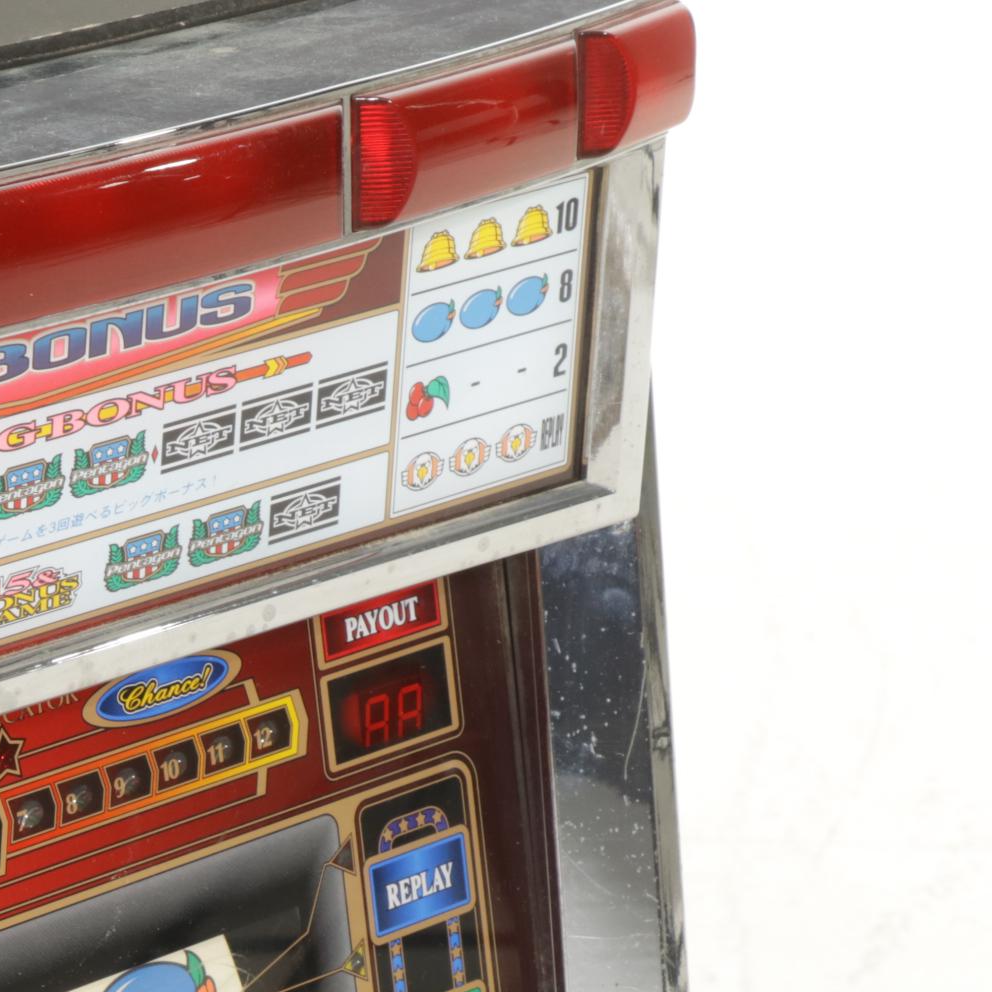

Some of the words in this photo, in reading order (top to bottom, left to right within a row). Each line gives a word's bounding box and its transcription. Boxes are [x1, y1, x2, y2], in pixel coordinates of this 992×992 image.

[555, 197, 579, 236] 10
[558, 268, 574, 303] 8
[552, 342, 568, 378] 2
[46, 364, 237, 441] BONUS
[320, 380, 384, 411] NET
[244, 402, 309, 433] NET
[165, 423, 233, 456] NET
[70, 451, 150, 483] Pentagon
[272, 495, 338, 528] NET
[190, 522, 264, 552] Pentagon
[106, 544, 182, 576] Pentagon
[344, 595, 420, 643] PAYOUT
[118, 663, 213, 713] Chance!
[253, 726, 274, 750] 12
[160, 758, 181, 781] 10
[207, 743, 226, 766] 11
[113, 775, 126, 799] 9
[66, 792, 78, 816] 8
[385, 861, 455, 912] REPLAY
